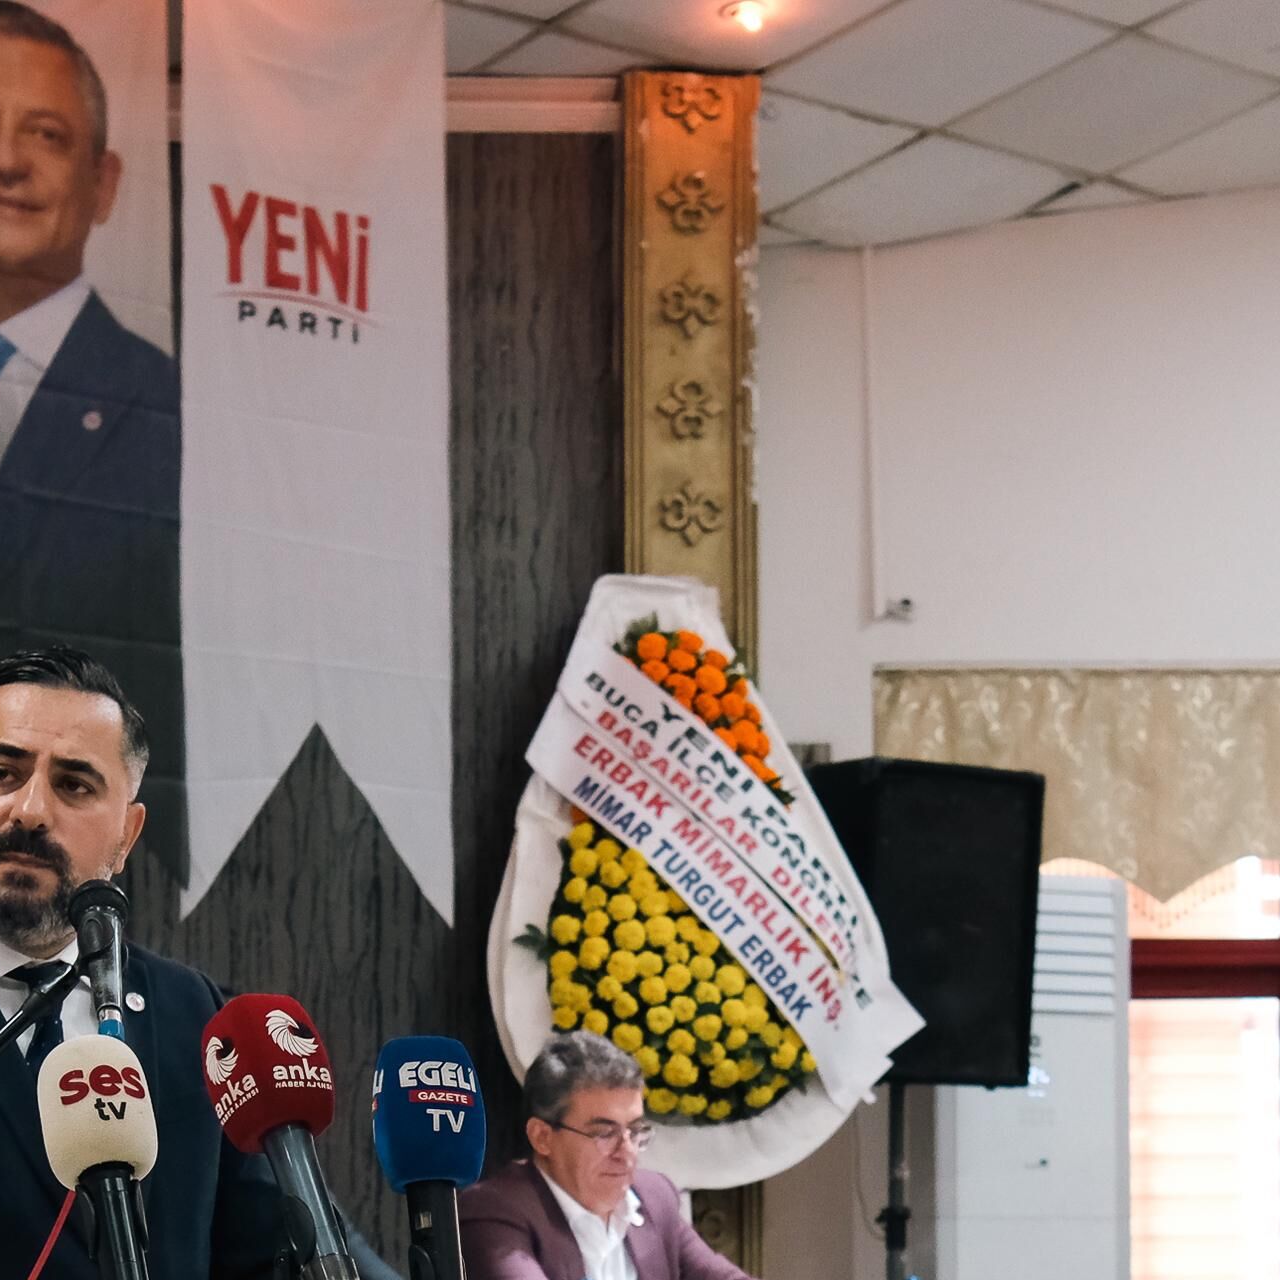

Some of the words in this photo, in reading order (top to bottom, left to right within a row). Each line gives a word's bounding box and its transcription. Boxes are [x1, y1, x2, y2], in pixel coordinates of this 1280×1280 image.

[586, 672, 659, 739] BUCA
[597, 711, 759, 856] BAŞARILAR
[574, 733, 673, 819] ERBAK
[671, 817, 811, 967] MİMARLIK
[573, 776, 652, 844] MİMAR
[651, 839, 745, 935] TURGUT
[738, 935, 813, 1022] ERBAK
[59, 1065, 145, 1105] ses
[273, 1058, 332, 1083] anka
[275, 1081, 305, 1089] HABER
[94, 1098, 127, 1120] tv
[215, 1074, 256, 1119] anka
[418, 1091, 468, 1104] GAZETE
[426, 1108, 465, 1133] TV
